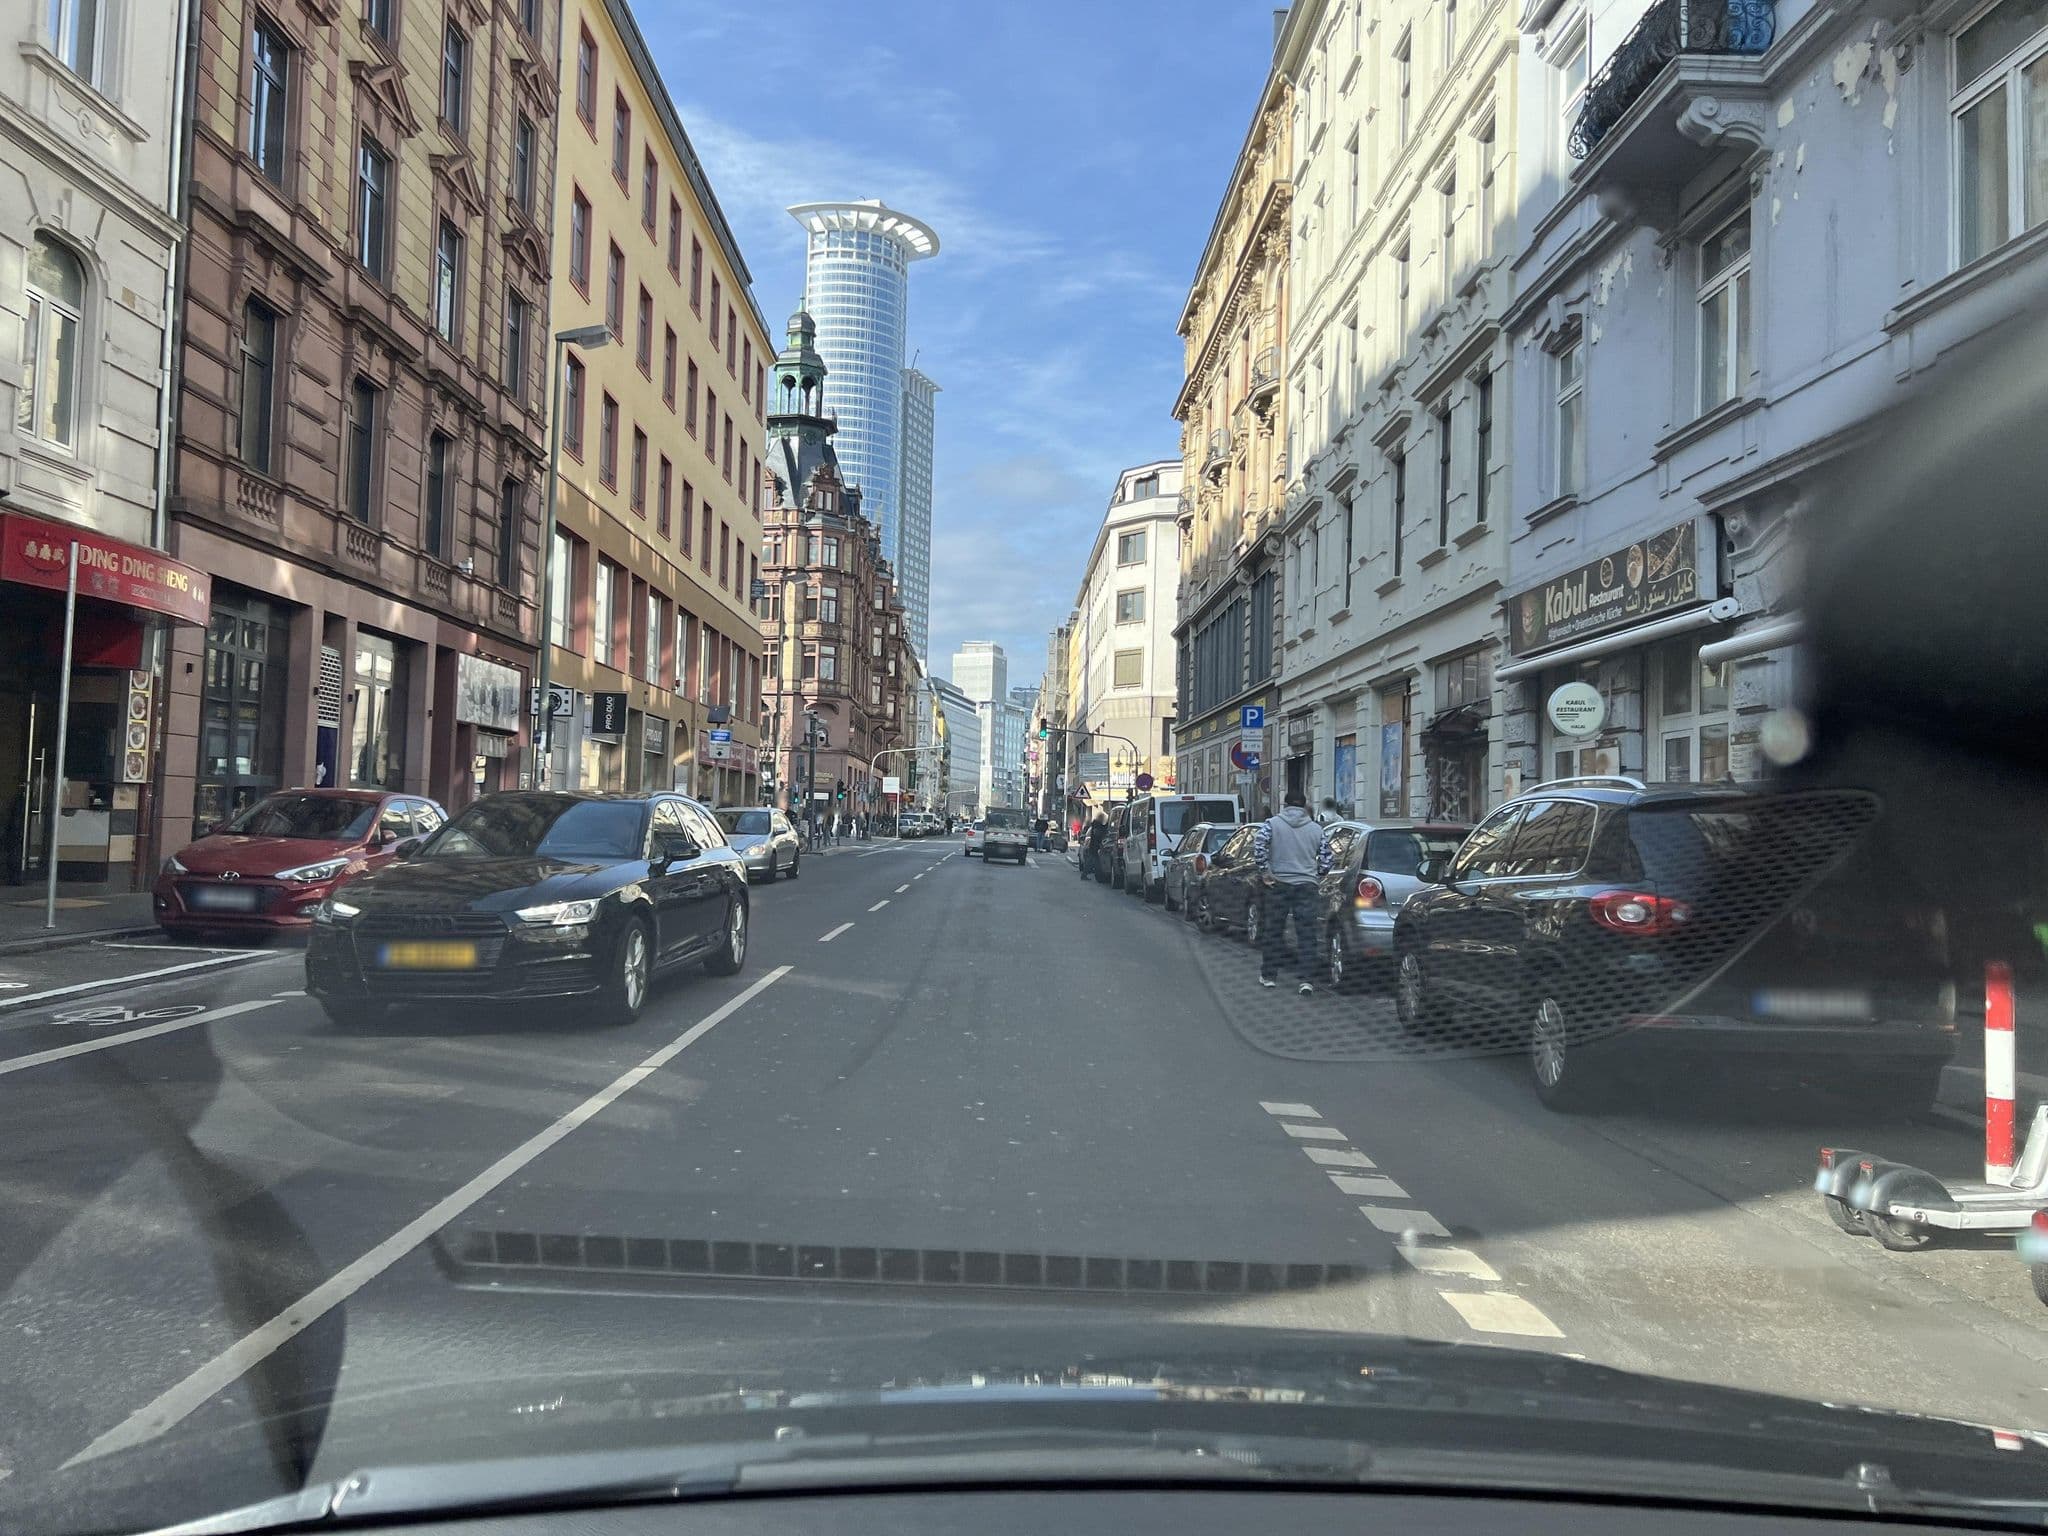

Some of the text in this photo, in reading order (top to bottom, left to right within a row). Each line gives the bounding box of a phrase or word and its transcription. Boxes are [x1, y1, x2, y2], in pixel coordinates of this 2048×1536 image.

[80, 545, 188, 592] DING DING SHENG
[1545, 571, 1625, 625] Kabul Restaurant
[605, 696, 614, 730] PRO DUO
[1247, 709, 1259, 726] P
